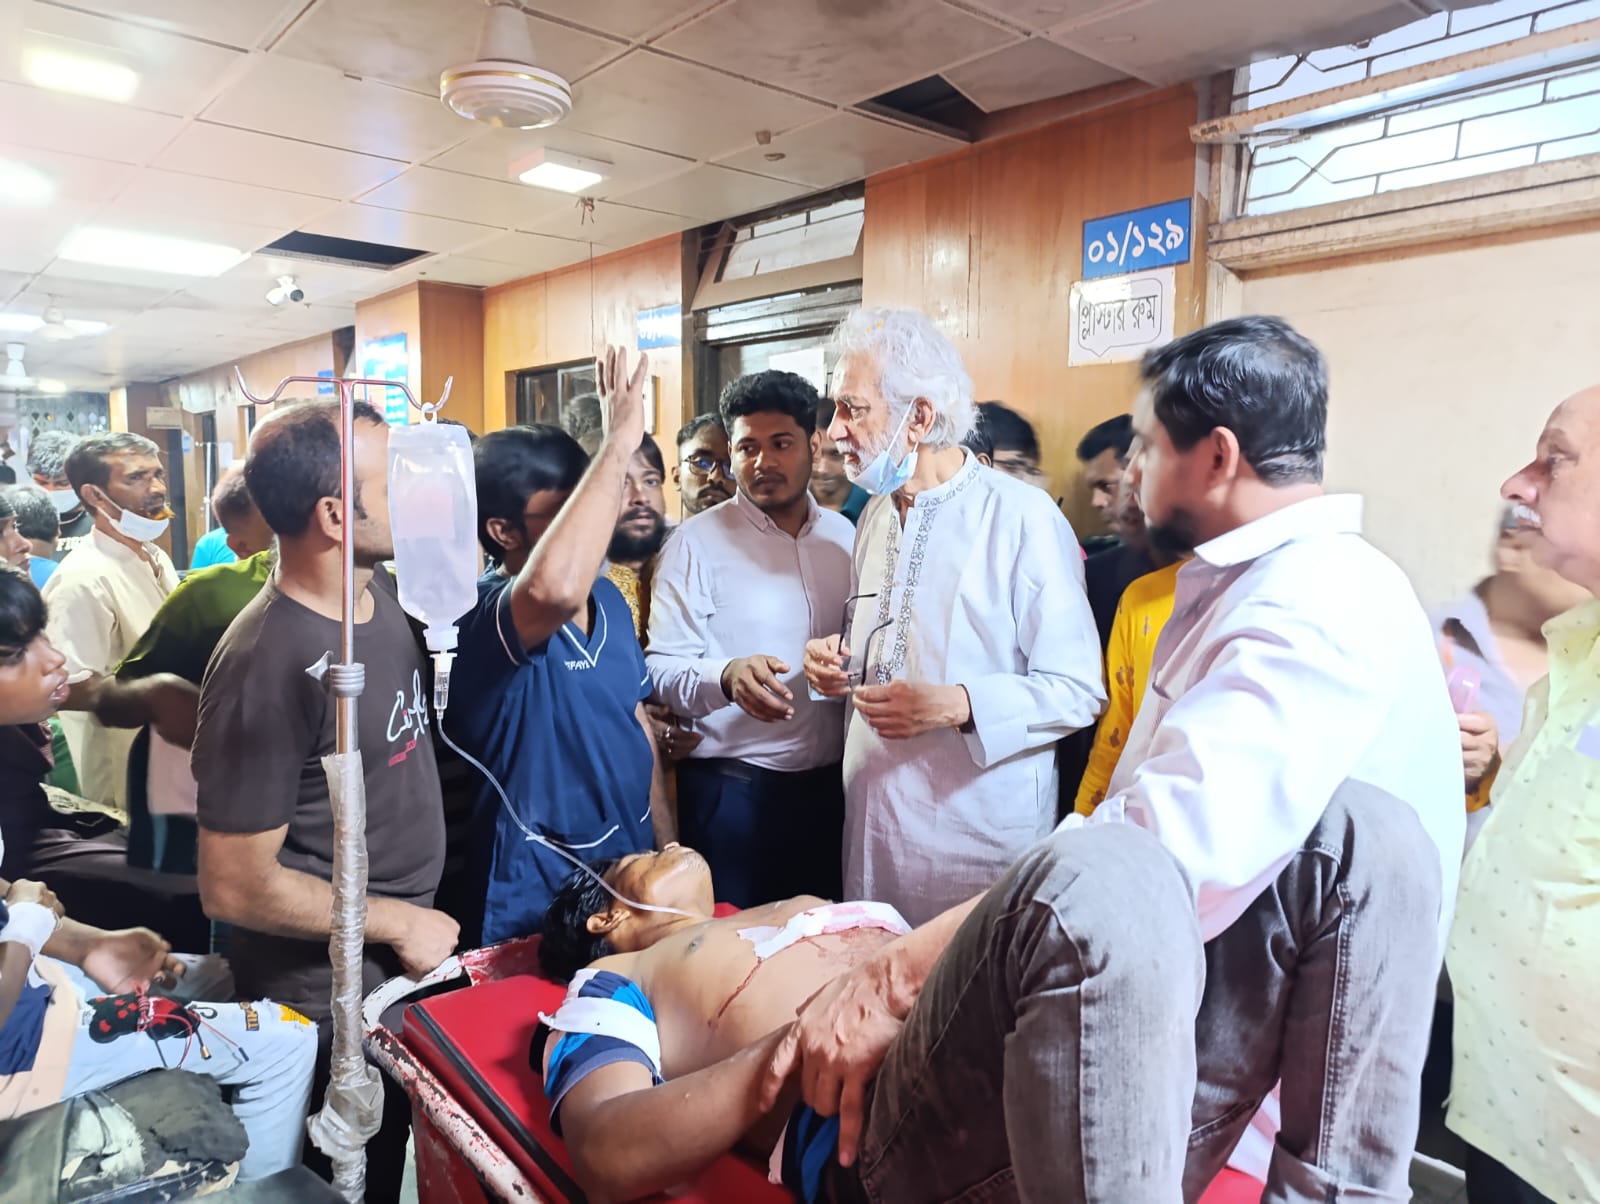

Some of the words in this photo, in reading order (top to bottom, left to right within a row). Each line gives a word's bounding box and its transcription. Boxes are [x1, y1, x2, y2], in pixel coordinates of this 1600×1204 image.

[1088, 218, 1184, 266] ০১/১২৯
[1081, 299, 1127, 340] প্লাস্টার
[1131, 295, 1158, 329] রুম
